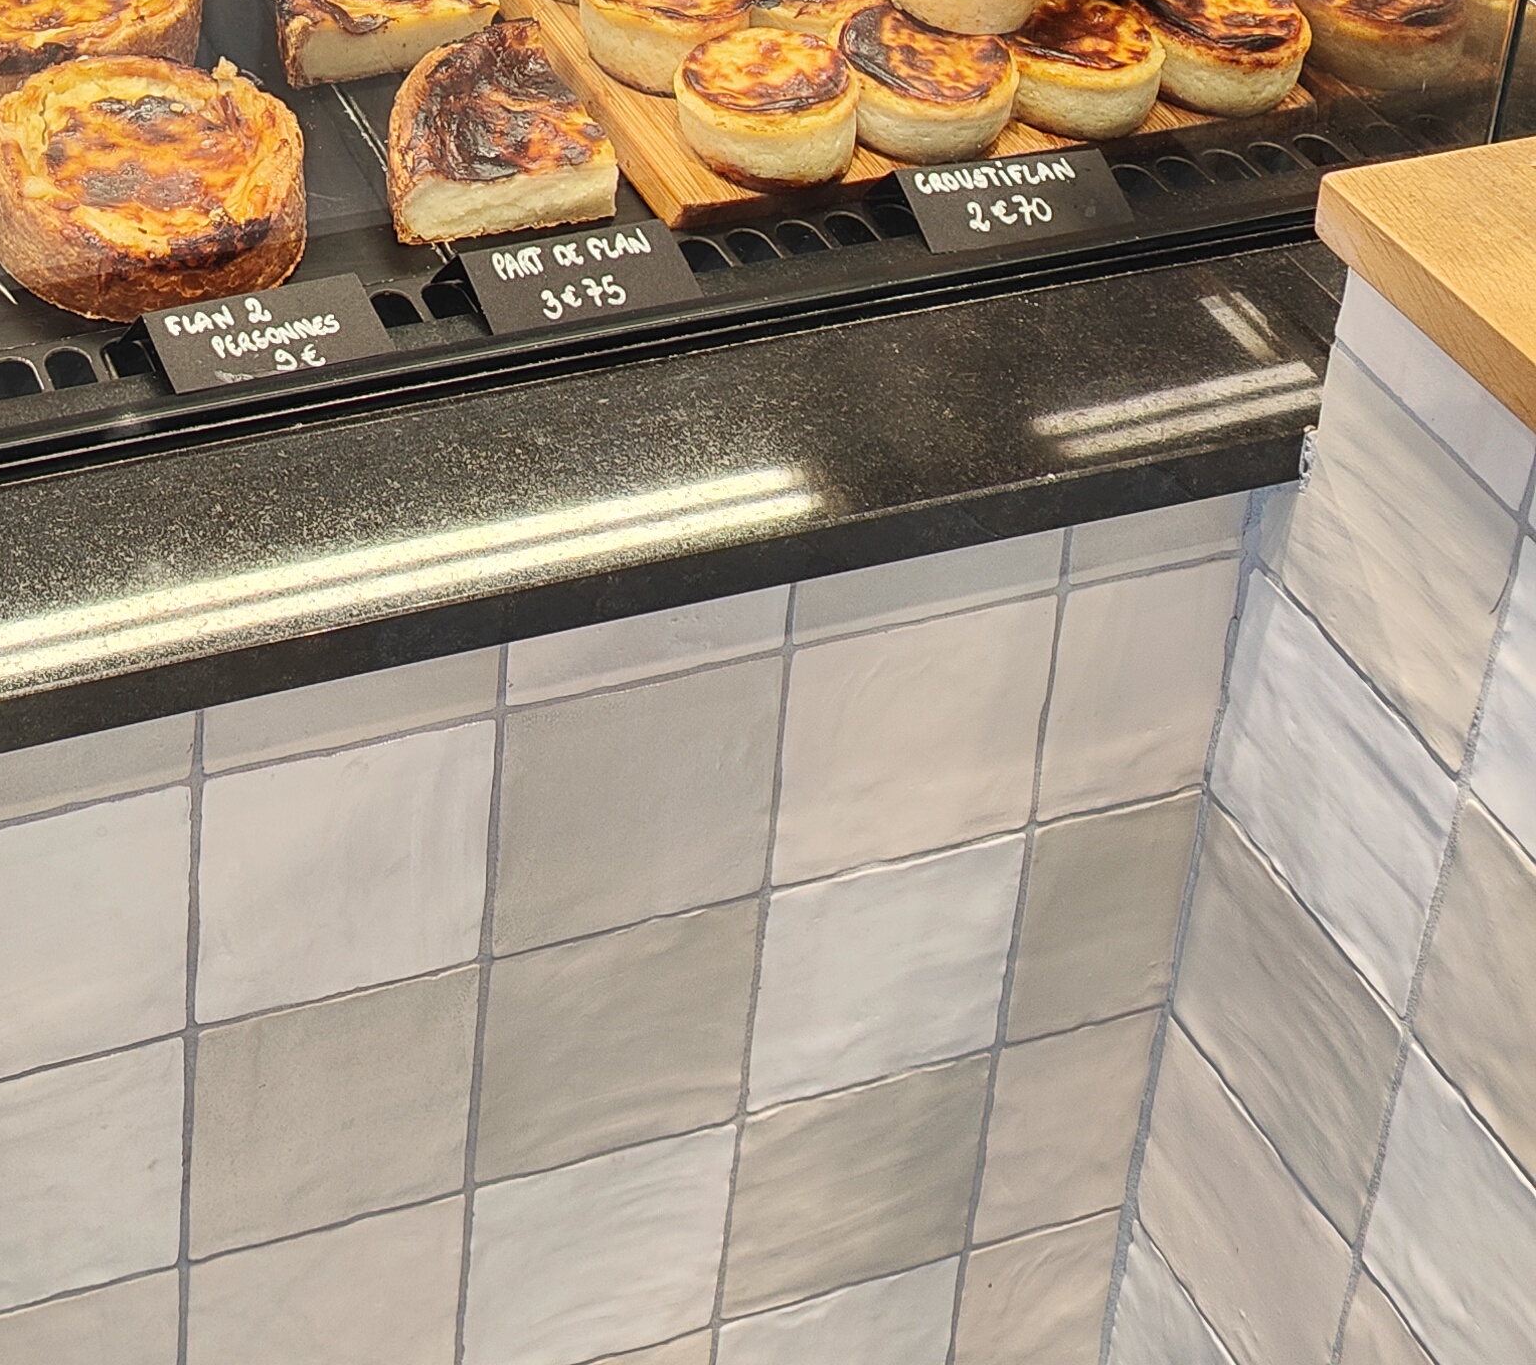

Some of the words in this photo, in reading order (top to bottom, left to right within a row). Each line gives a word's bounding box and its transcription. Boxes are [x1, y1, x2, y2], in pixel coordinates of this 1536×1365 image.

[491, 245, 544, 281] PART
[552, 242, 584, 267] DE
[586, 227, 652, 261] FLAN
[164, 304, 235, 337] FLAN
[244, 297, 272, 324] 2
[210, 313, 341, 359] PERSONNES
